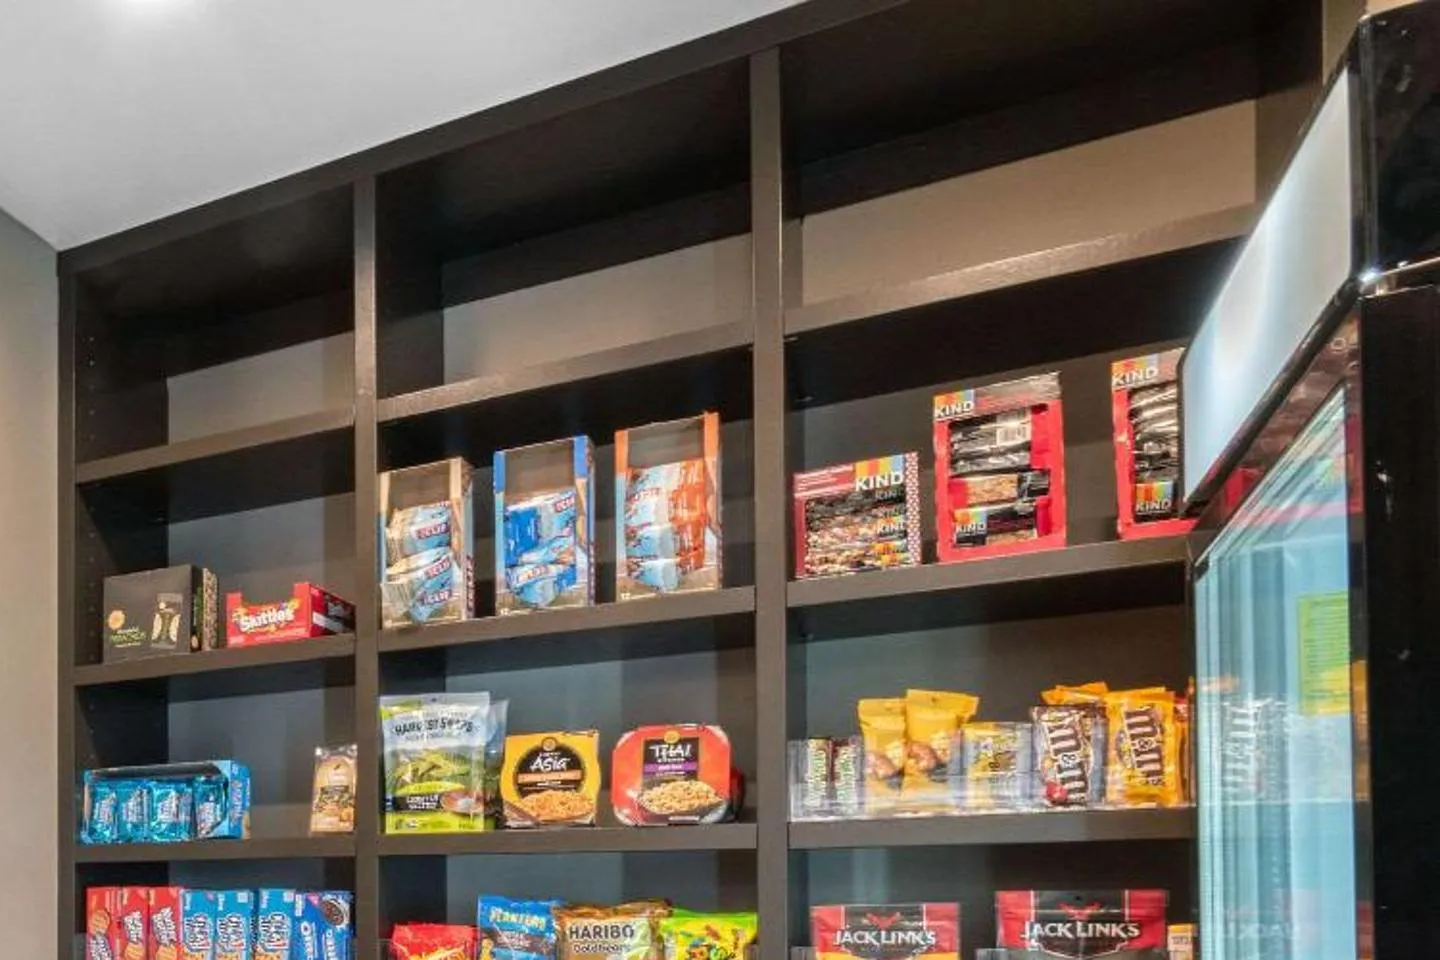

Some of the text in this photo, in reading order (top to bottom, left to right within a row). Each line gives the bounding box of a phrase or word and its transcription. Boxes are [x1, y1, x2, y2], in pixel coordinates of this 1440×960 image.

[1112, 367, 1158, 387] KIND
[935, 400, 975, 418] KIND
[854, 471, 904, 492] KIND
[1135, 499, 1172, 513] KIND
[954, 522, 988, 534] KIND
[239, 606, 295, 632] Skittles
[649, 743, 692, 758] THAI
[568, 923, 635, 942] HARIBO
[834, 929, 879, 946] JACK
[1020, 920, 1073, 939] JACK
